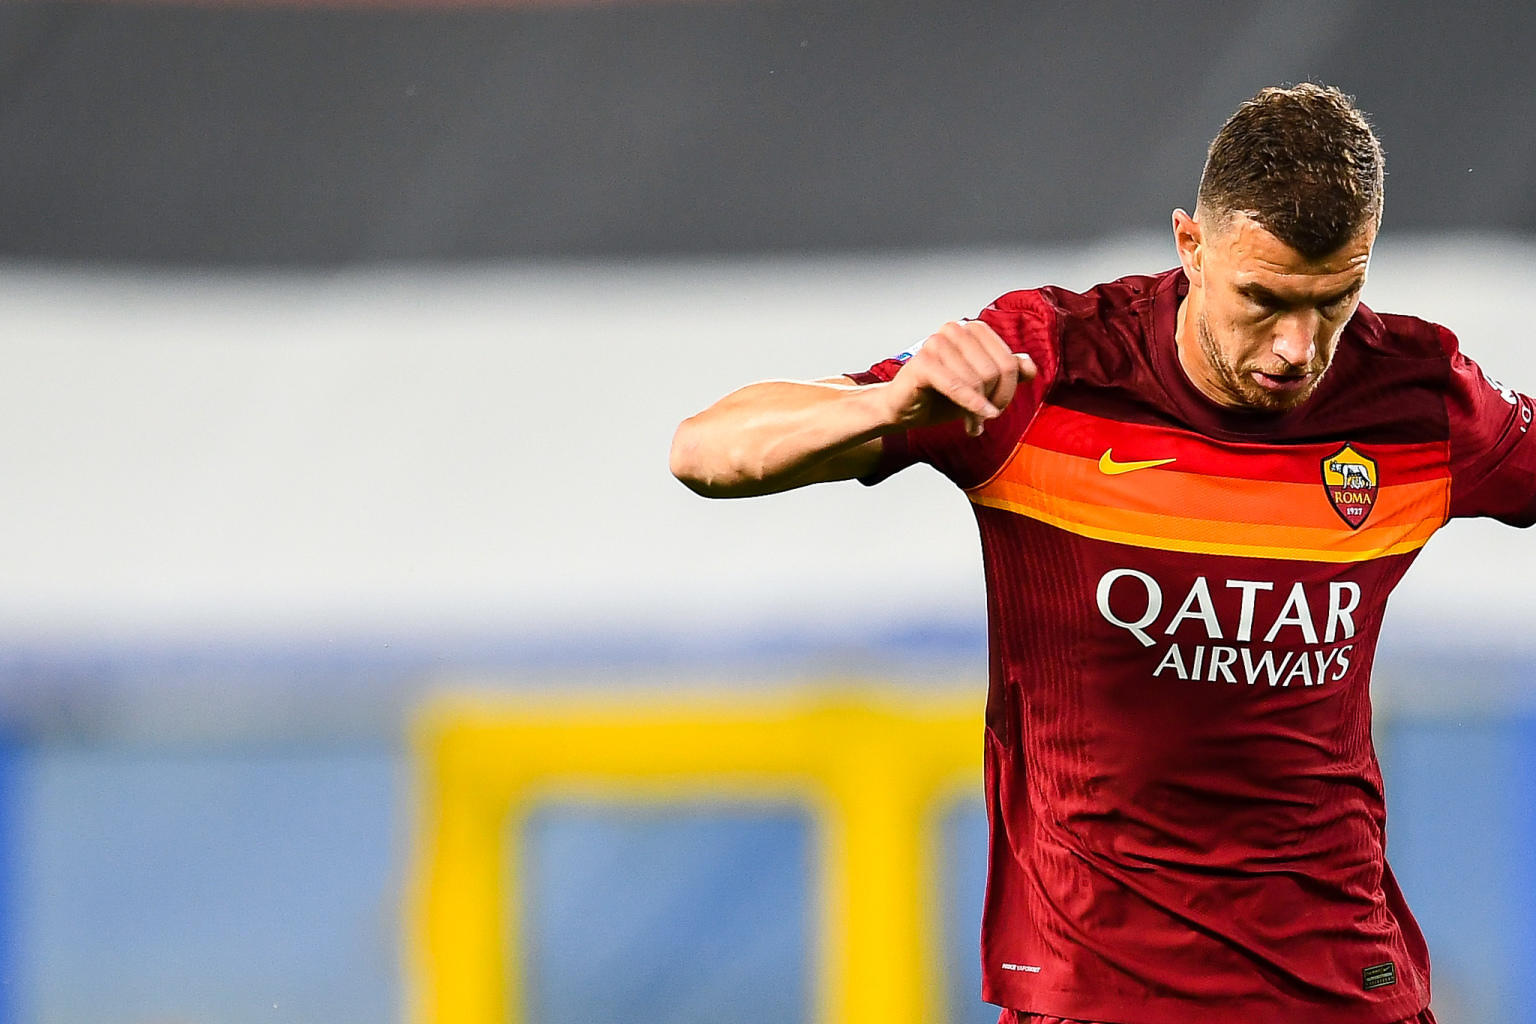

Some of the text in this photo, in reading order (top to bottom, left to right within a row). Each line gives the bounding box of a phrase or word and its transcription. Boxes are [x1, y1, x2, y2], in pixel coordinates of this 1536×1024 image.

[1334, 491, 1372, 505] ROMA
[1346, 507, 1363, 516] 1927
[1096, 568, 1361, 647] QATAR
[1152, 643, 1353, 687] AIRWAYS
